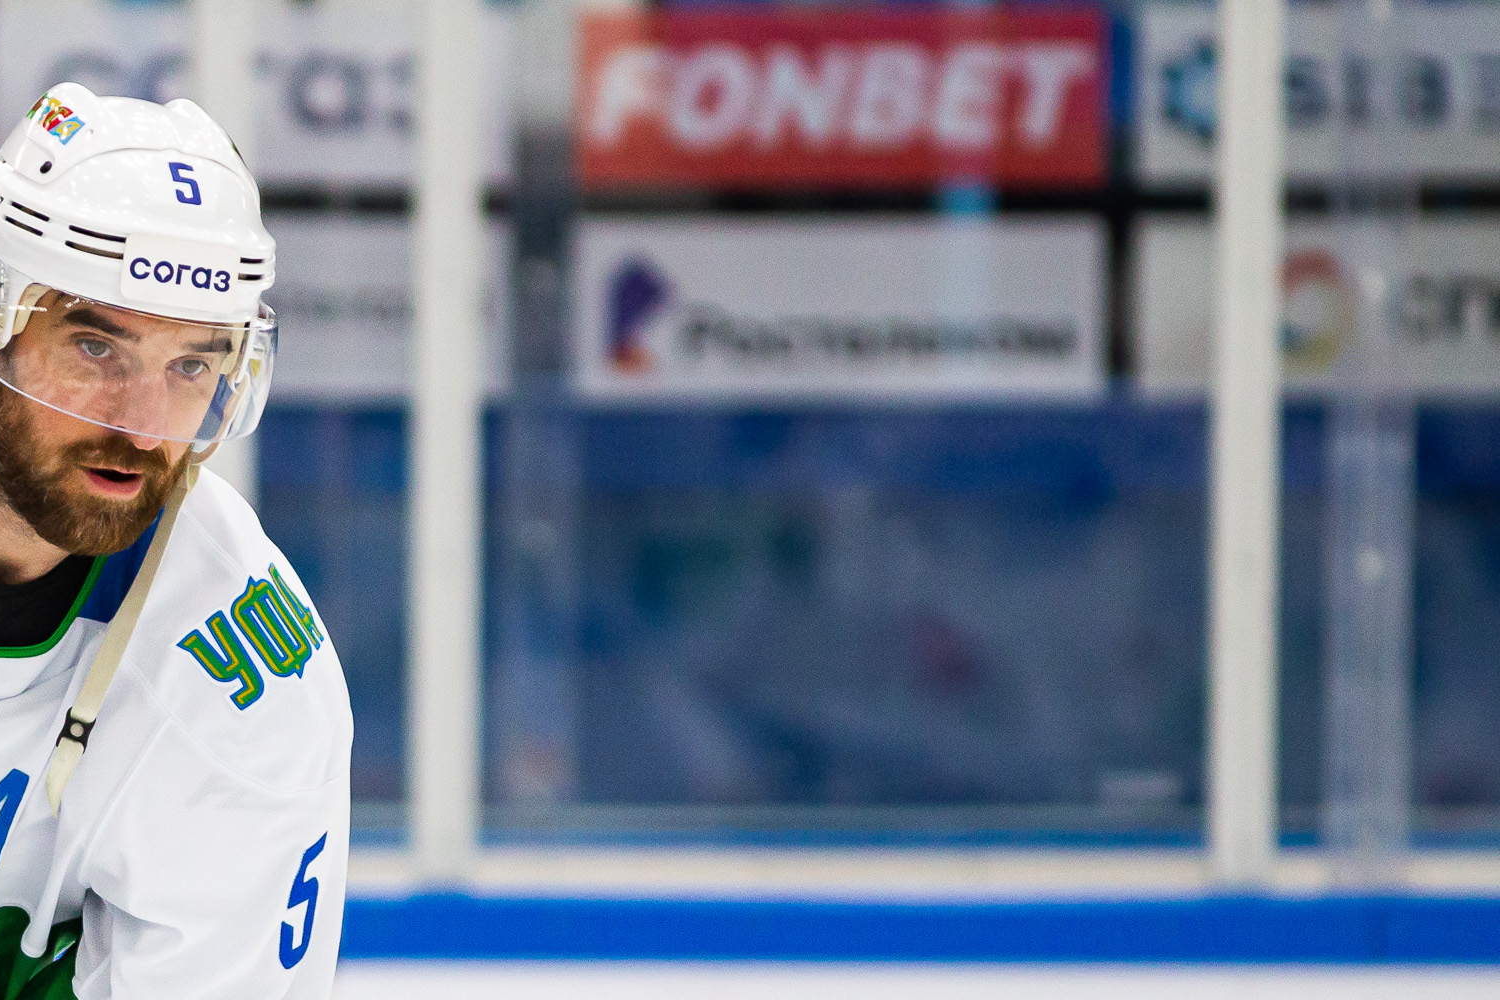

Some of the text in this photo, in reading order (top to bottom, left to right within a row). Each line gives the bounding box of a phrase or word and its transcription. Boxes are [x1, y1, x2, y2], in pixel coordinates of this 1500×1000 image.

[592, 45, 1088, 148] FONBET
[168, 161, 202, 205] 5
[175, 562, 325, 711] УФА
[278, 831, 329, 970] 5
